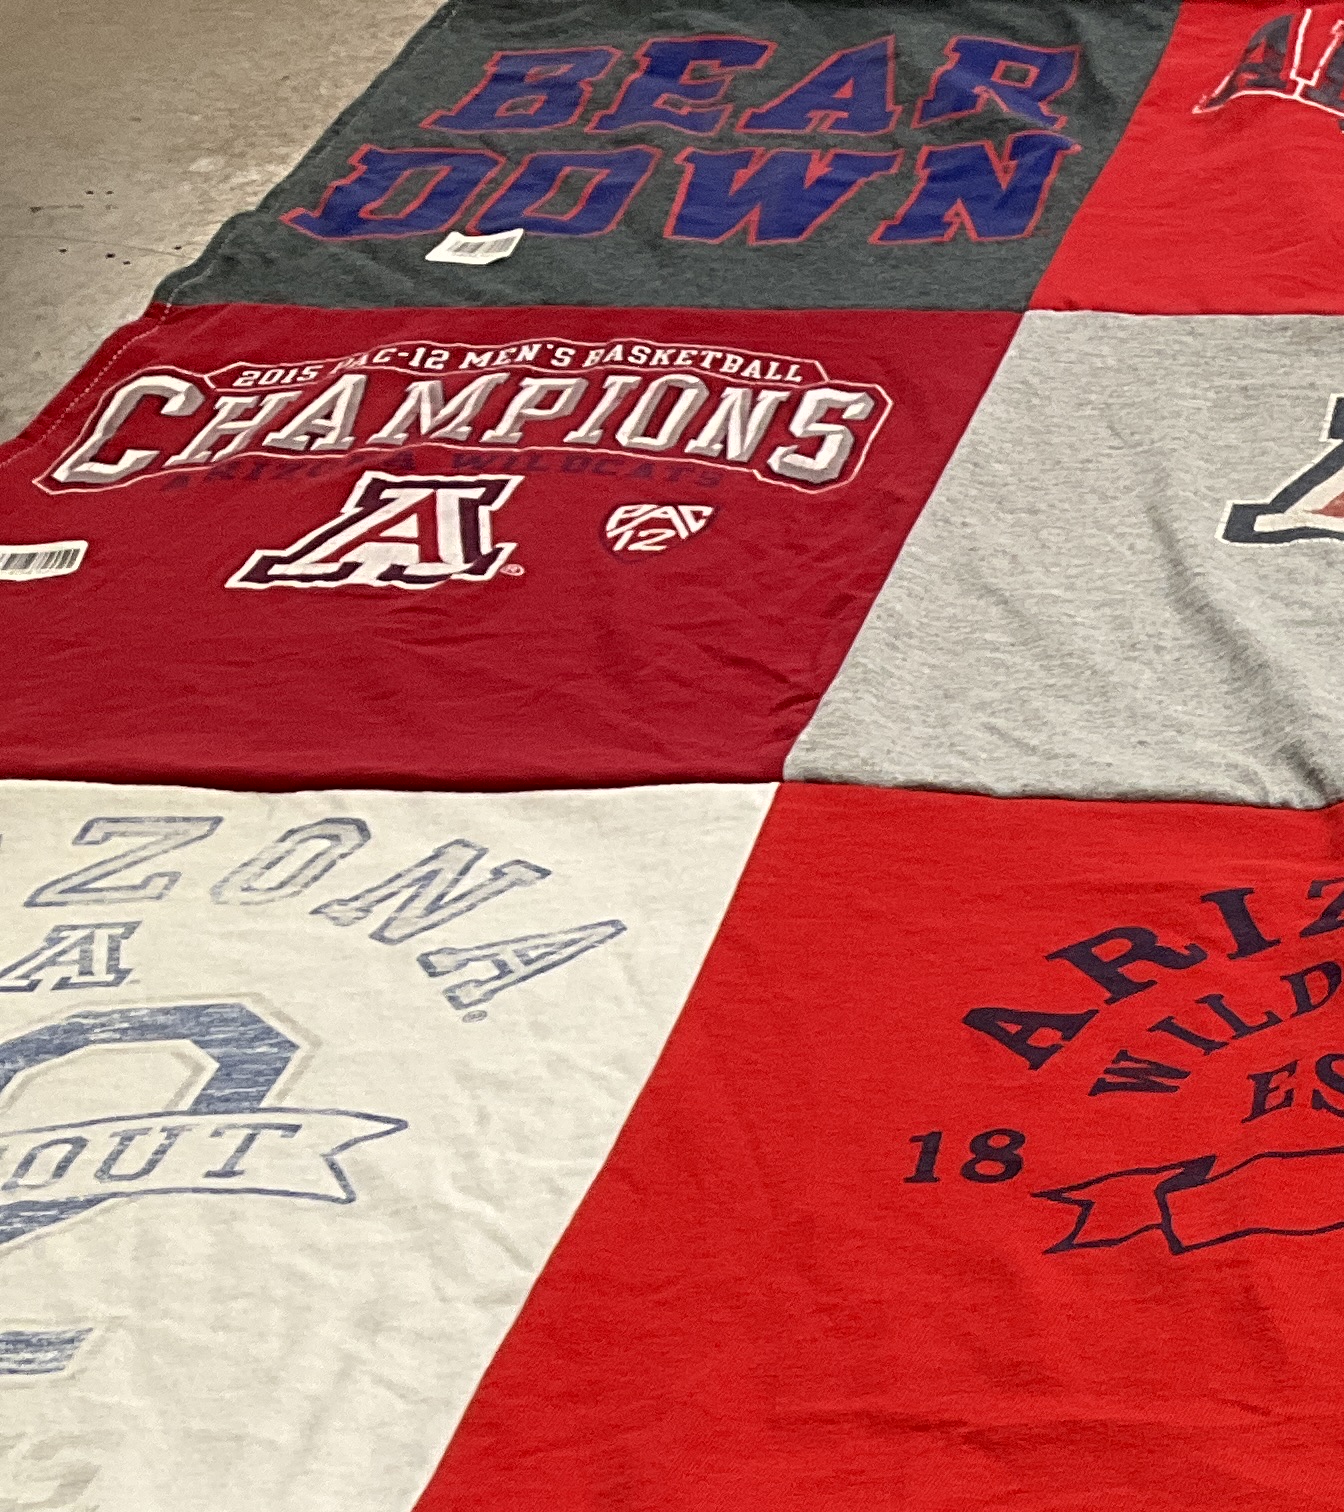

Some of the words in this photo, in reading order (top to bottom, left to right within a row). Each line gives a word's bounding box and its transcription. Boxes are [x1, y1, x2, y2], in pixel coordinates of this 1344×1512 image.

[420, 35, 1084, 136] BEAR
[280, 132, 1082, 246] DOWN
[232, 365, 324, 387] 2015
[458, 343, 576, 370] MEN'S
[582, 343, 804, 384] BASKETBALL
[51, 372, 876, 485] CHAMPIONS
[225, 471, 525, 590] A
[605, 503, 717, 540] PAC
[612, 527, 678, 552] 12
[0, 815, 628, 1010] ZONA
[0, 1122, 303, 1192] OUT
[903, 1128, 1027, 1184] 18
